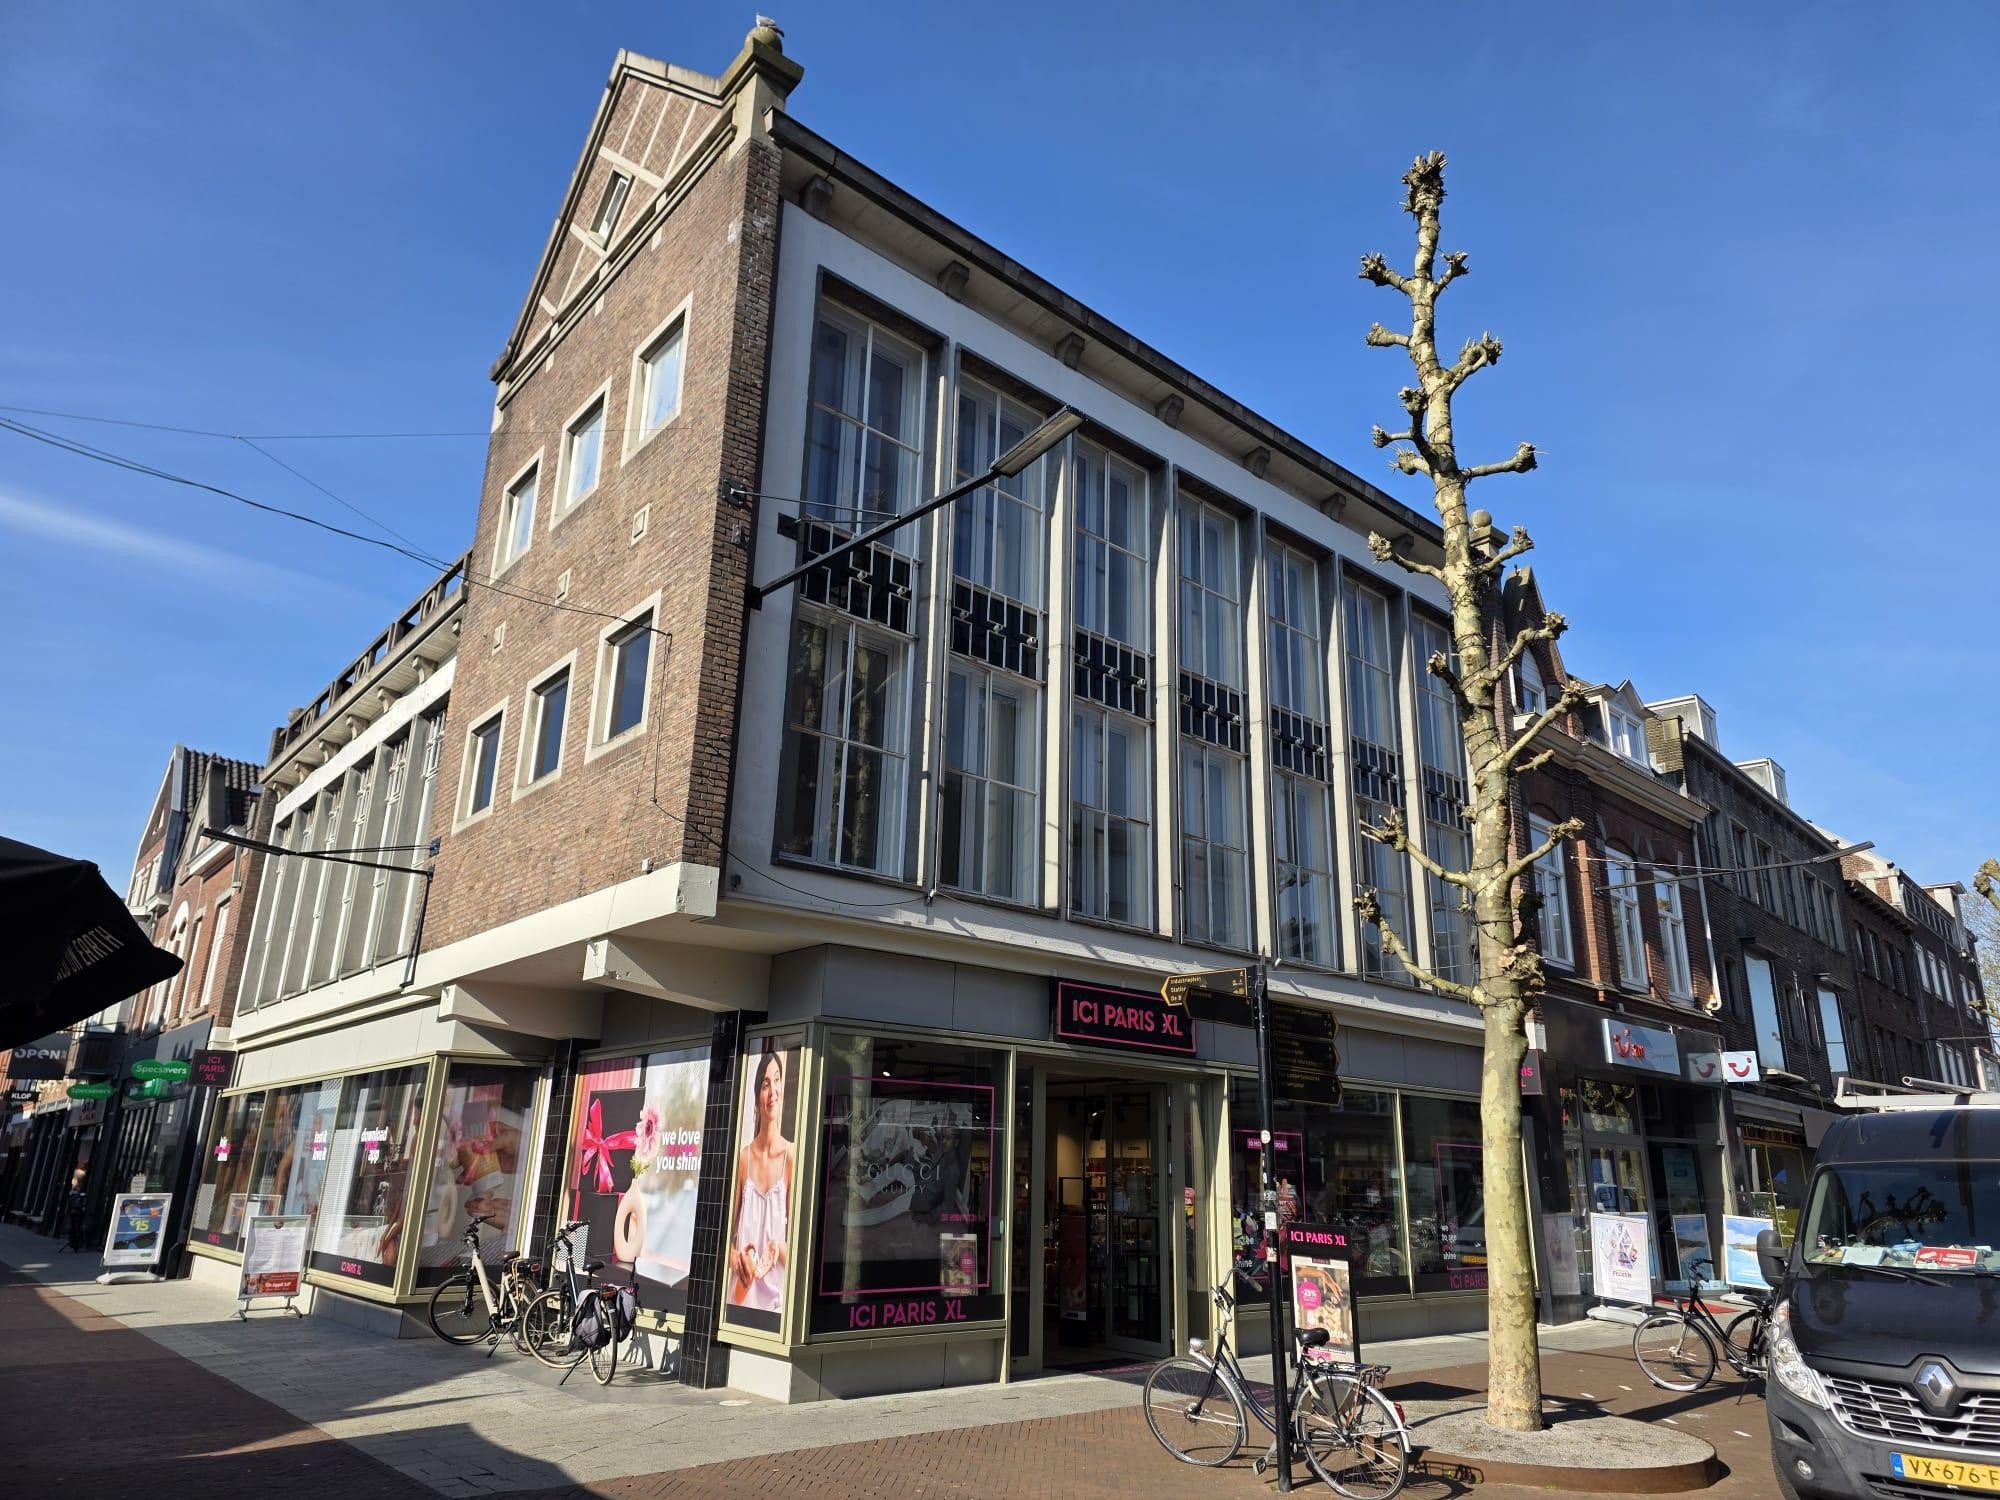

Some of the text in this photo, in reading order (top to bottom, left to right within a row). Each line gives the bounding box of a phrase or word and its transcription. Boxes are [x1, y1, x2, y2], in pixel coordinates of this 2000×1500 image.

[72, 925, 125, 967] EARTH
[1072, 999, 1183, 1036] ICI PARIS XL
[207, 1056, 221, 1064] ICI
[136, 1065, 187, 1075] Specsavers
[198, 1064, 226, 1073] PARIS
[204, 1073, 216, 1081] XL
[662, 1126, 701, 1146] we love
[655, 1155, 675, 1174] you
[867, 1163, 941, 1181] GUCCI
[880, 1184, 928, 1195] GUILTY
[1290, 1230, 1348, 1246] ICI PARIS XL
[1235, 1256, 1253, 1267] shine
[1451, 1273, 1489, 1289] ICI PARIS
[850, 1300, 967, 1328] ICI PARIS XL
[1908, 1459, 2000, 1486] VX-676-F
